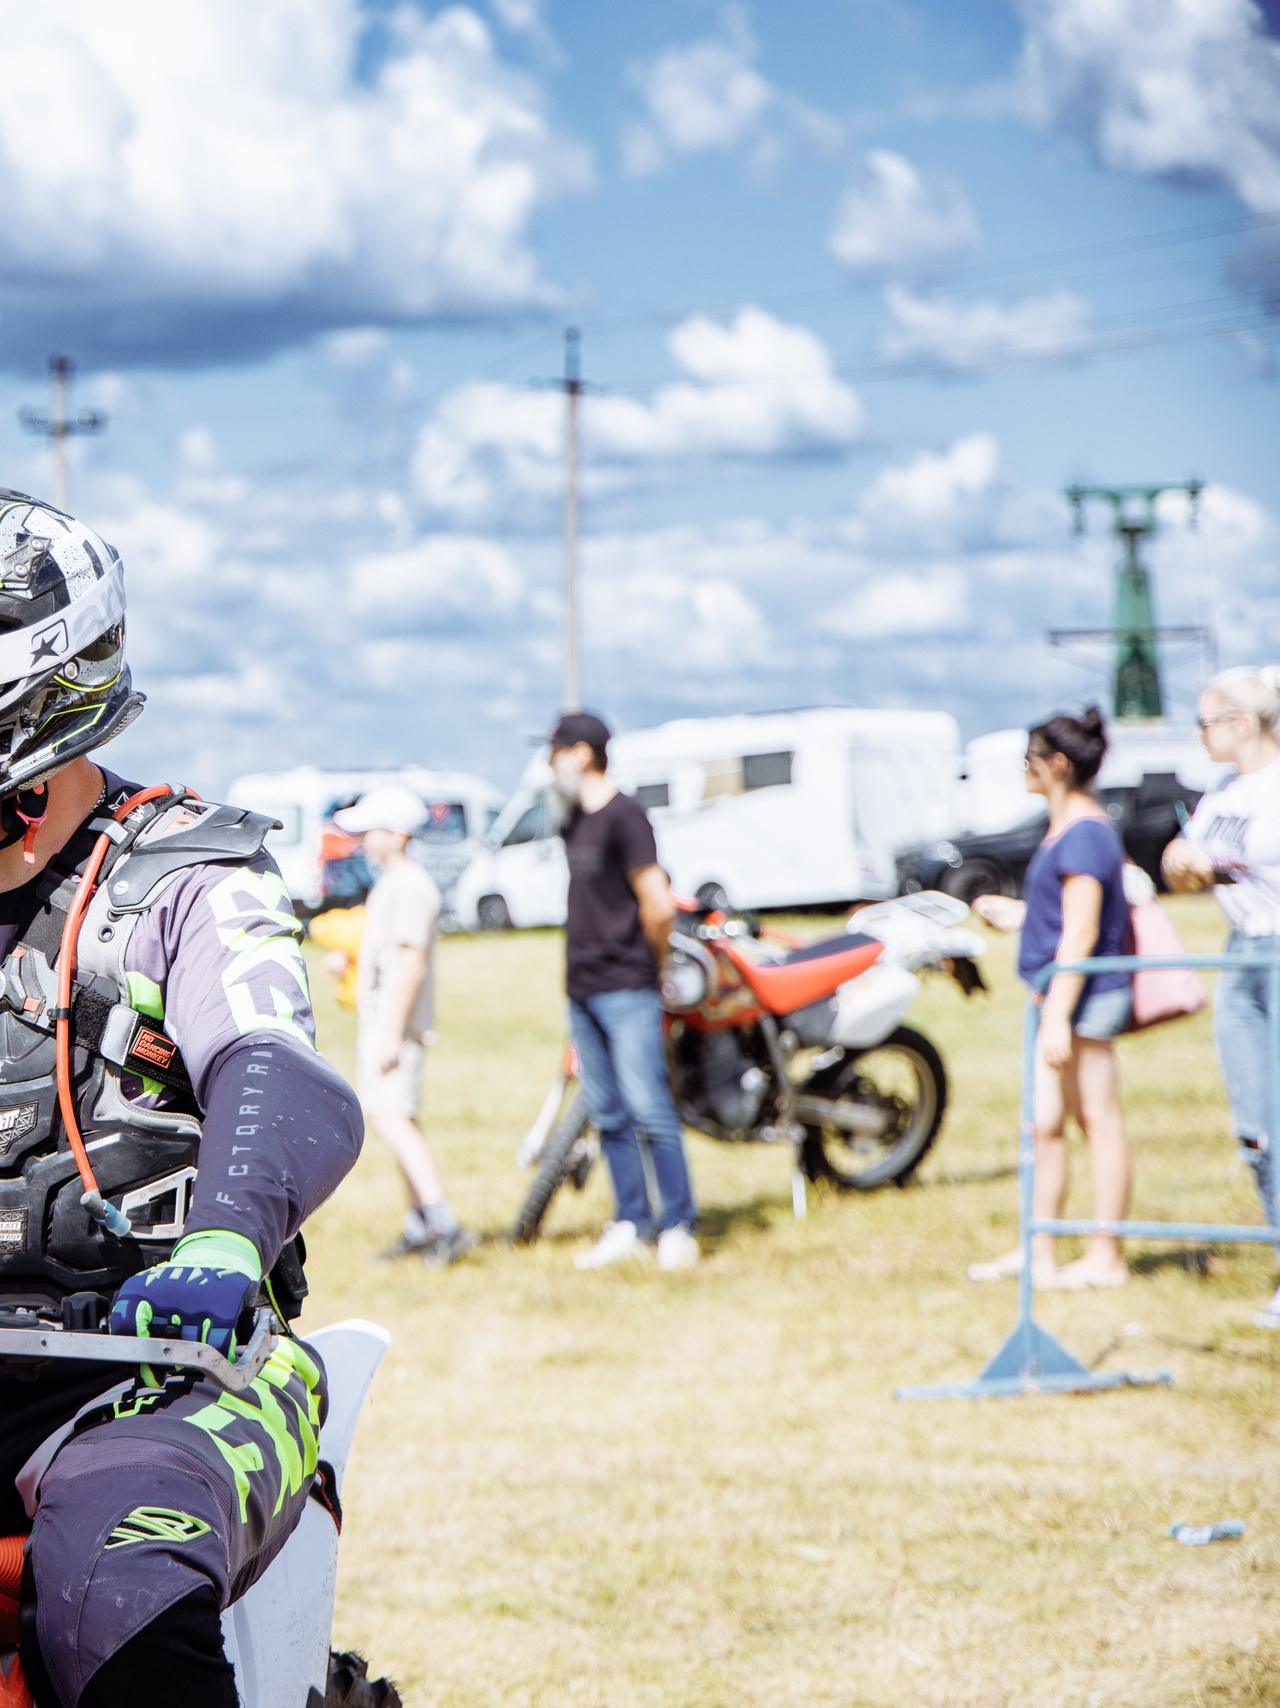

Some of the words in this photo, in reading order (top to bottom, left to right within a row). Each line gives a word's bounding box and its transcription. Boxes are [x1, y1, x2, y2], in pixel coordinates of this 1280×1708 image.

[142, 1033, 155, 1044] NO
[135, 1046, 168, 1064] MONKEY
[139, 1040, 172, 1058] DANCING
[216, 1086, 265, 1206] FCTORY
